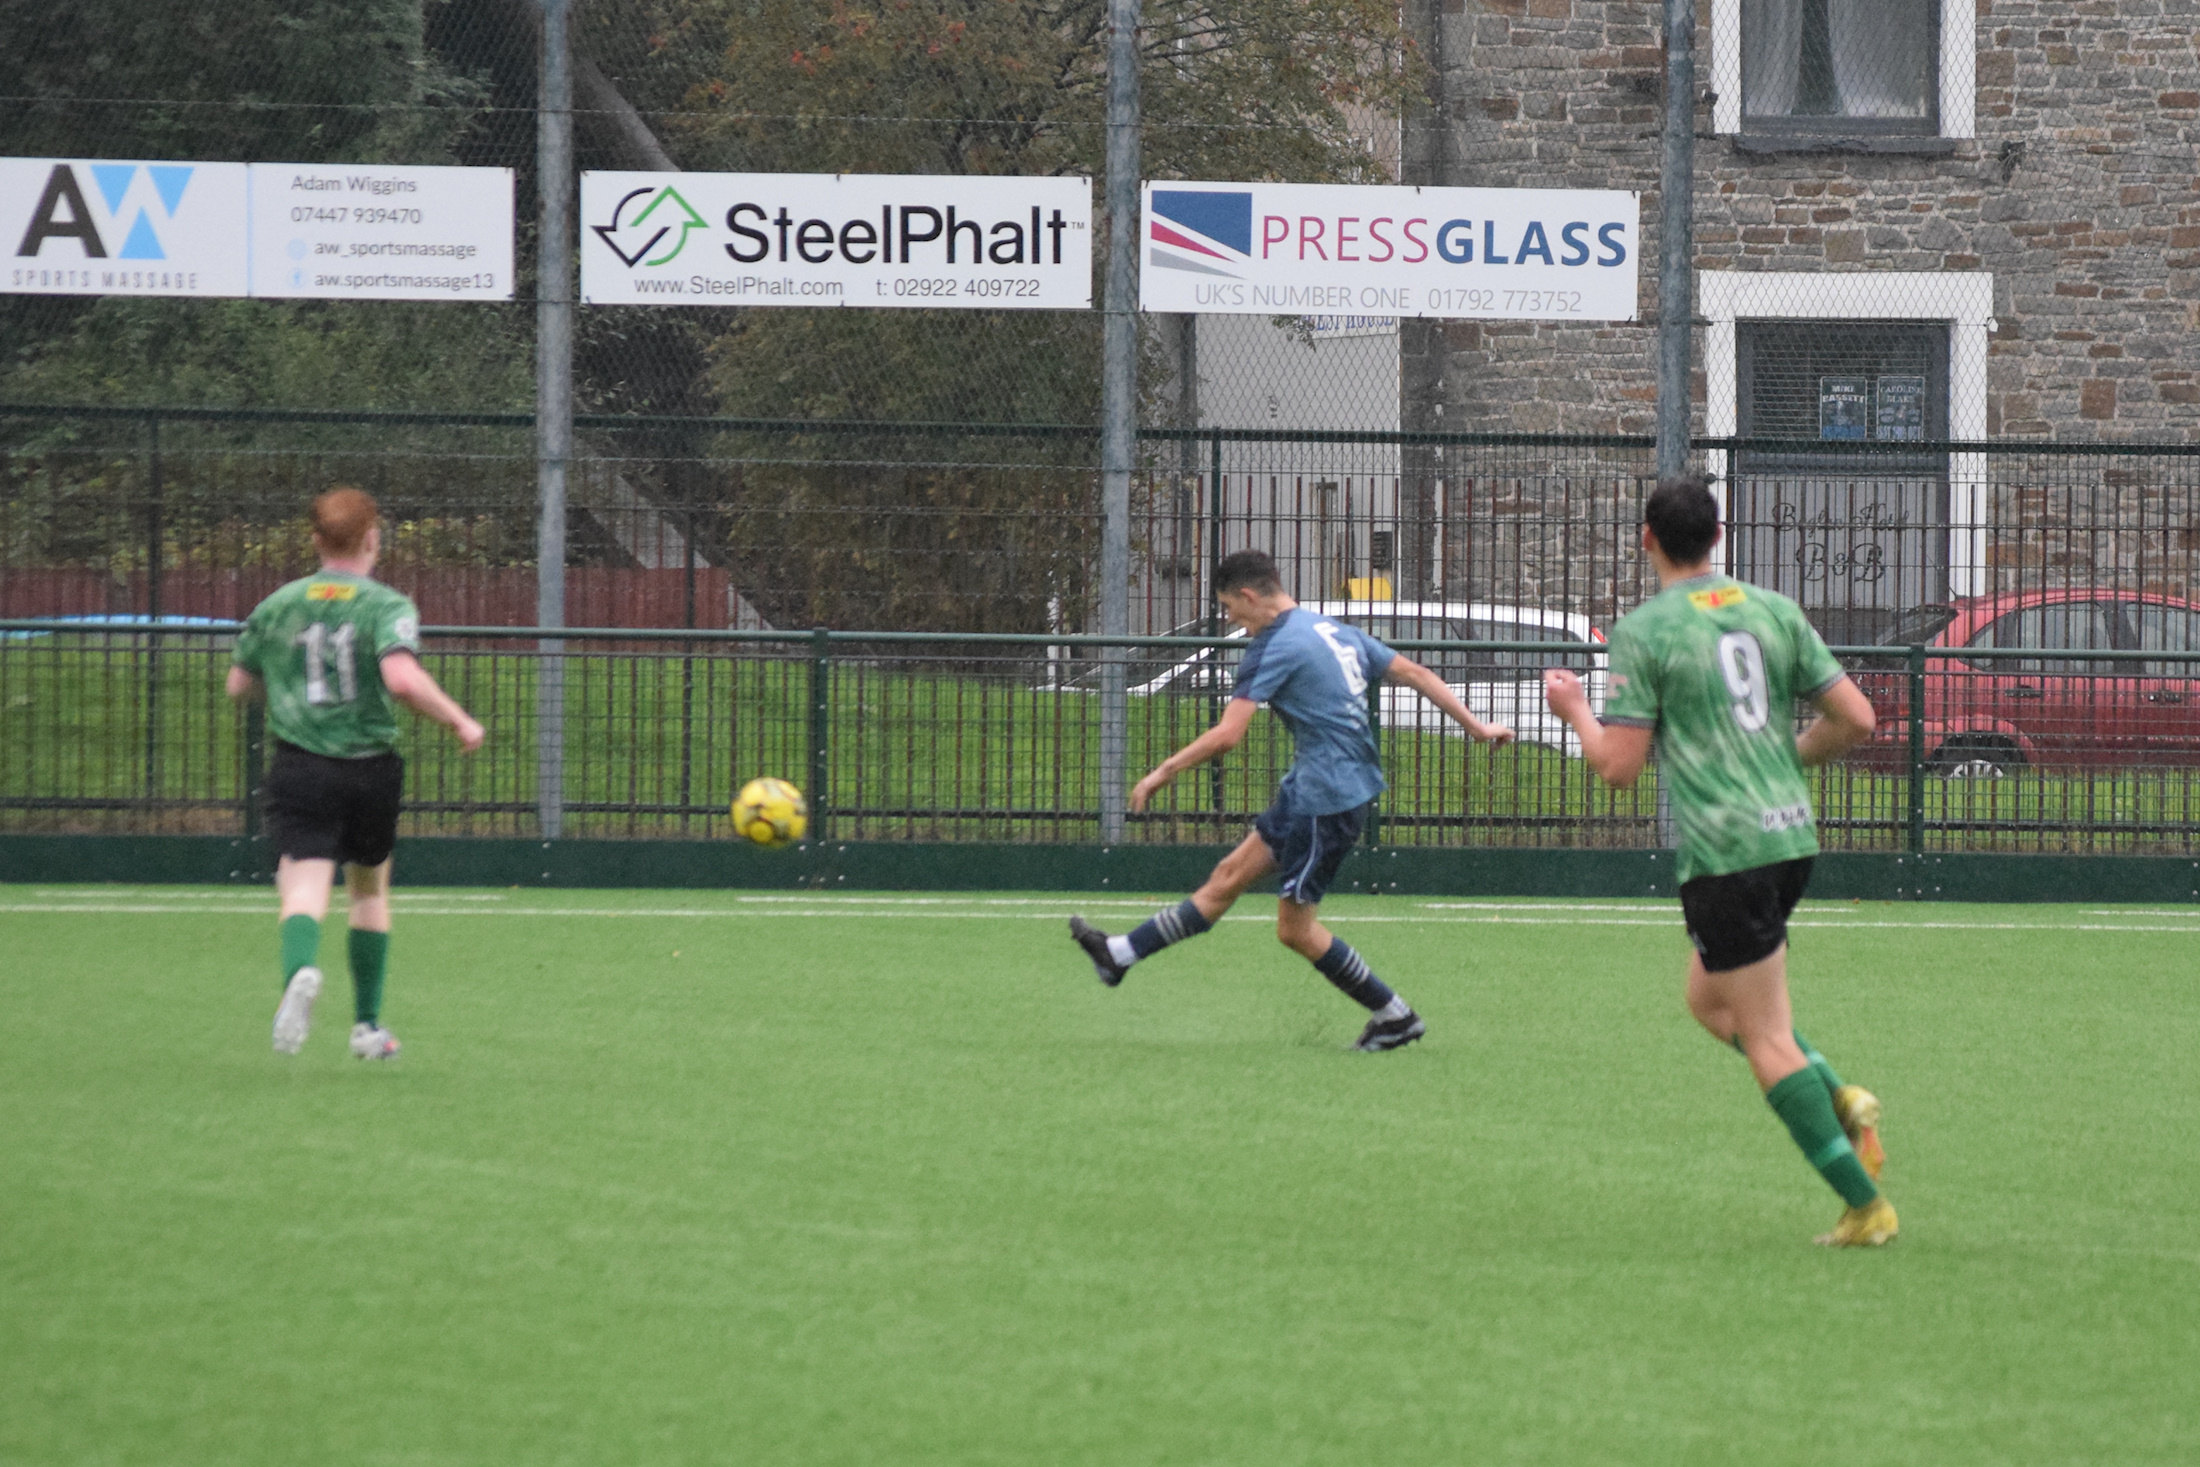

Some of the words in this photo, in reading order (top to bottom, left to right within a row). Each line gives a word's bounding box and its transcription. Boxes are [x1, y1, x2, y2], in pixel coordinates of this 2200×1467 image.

[291, 175, 341, 191] Adam
[347, 176, 417, 195] Wiggins
[291, 206, 348, 222] 07447
[353, 208, 422, 224] 939470
[723, 202, 1067, 264] SteelPhalt
[1262, 215, 1628, 267] PRESSGLASS
[314, 242, 477, 259] aw_sportsmassage
[12, 269, 91, 287] SPORTS
[101, 271, 199, 290] MASSAGE
[314, 273, 494, 291] aw.sportsmassage13
[634, 275, 843, 296] www.SteelPhalt.com
[876, 279, 887, 296] t:
[894, 278, 957, 297] 02922
[964, 278, 1041, 298] 409722
[1195, 284, 1245, 306] UK'S
[1252, 285, 1352, 308] NUMBER
[1360, 287, 1410, 310] ONE
[1429, 288, 1495, 311] 01792
[1503, 290, 1582, 313] 773752
[297, 622, 356, 704] 11
[1718, 629, 1770, 733] 9
